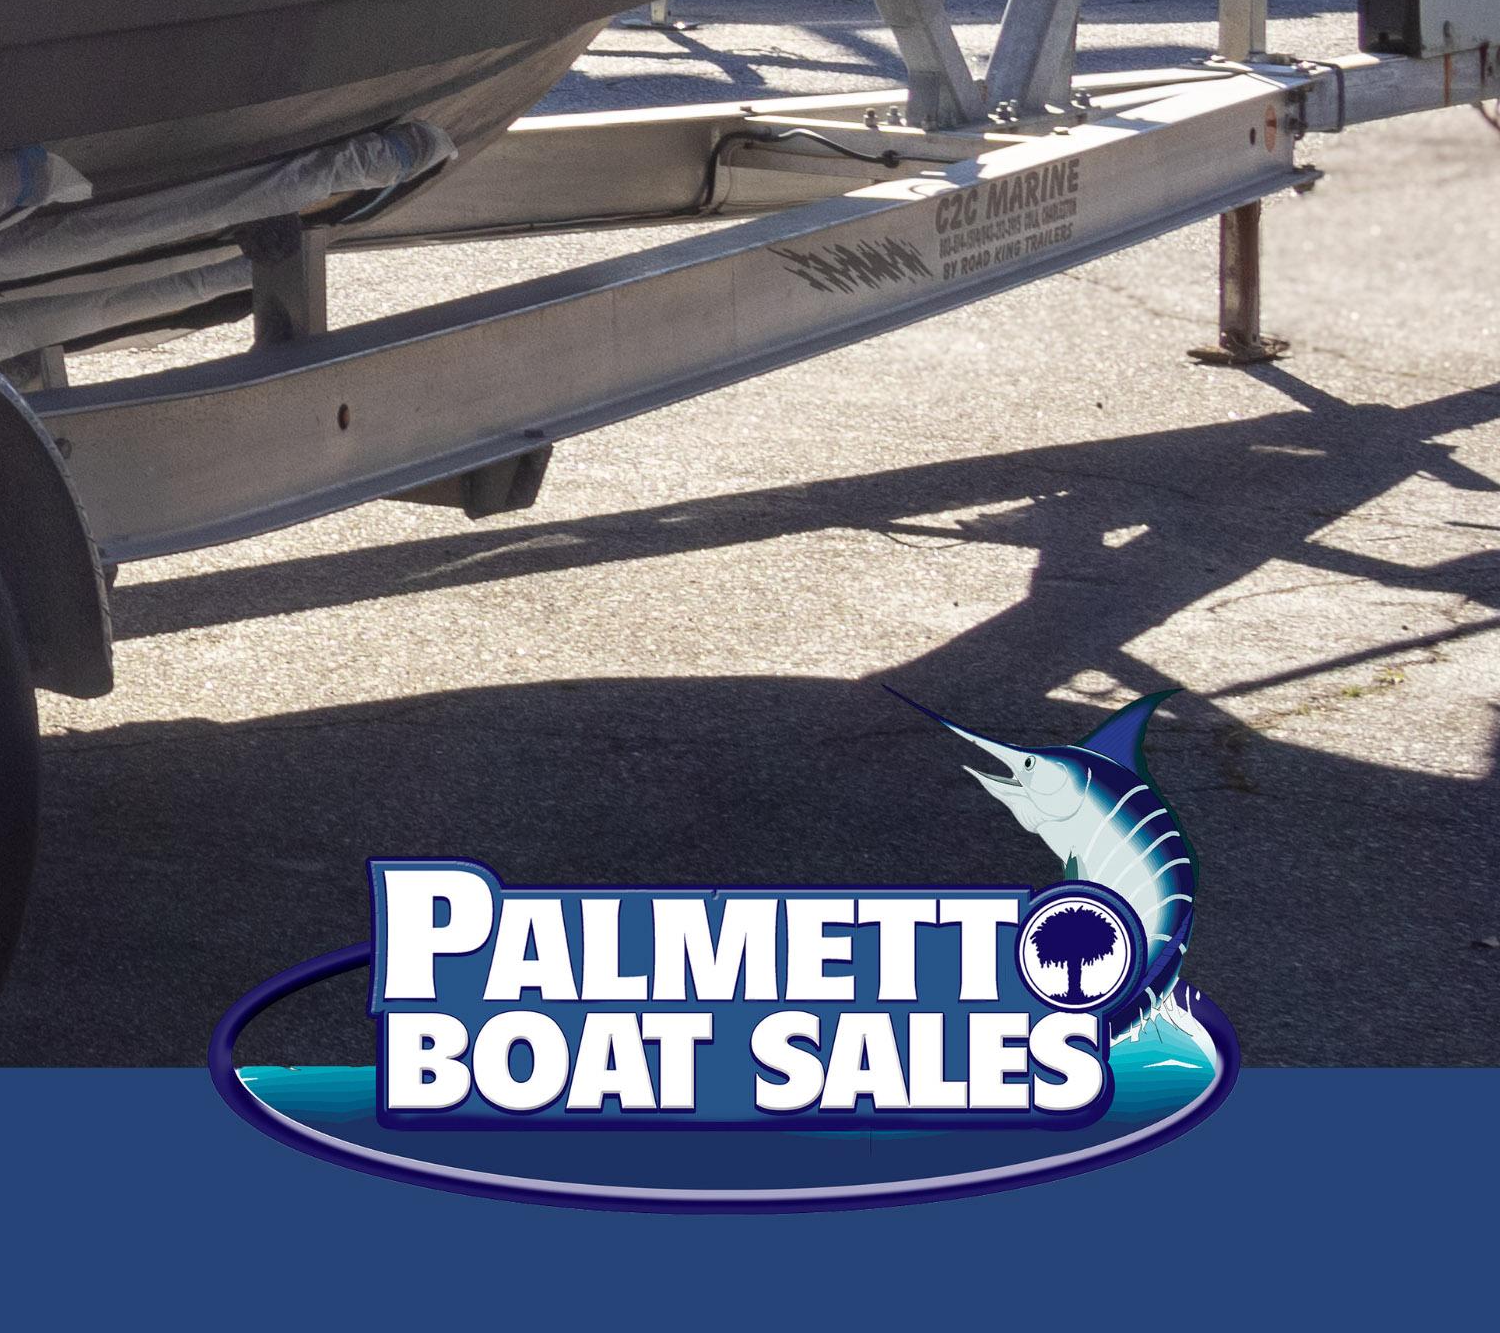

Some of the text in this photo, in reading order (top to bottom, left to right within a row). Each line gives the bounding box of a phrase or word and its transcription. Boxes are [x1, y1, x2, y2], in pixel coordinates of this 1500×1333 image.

[935, 188, 979, 234] C2C
[986, 158, 1081, 220] MARINE
[943, 259, 958, 281] BY
[961, 250, 991, 276] ROAD
[994, 239, 1021, 264] KING
[1024, 222, 1074, 254] TRAILERS
